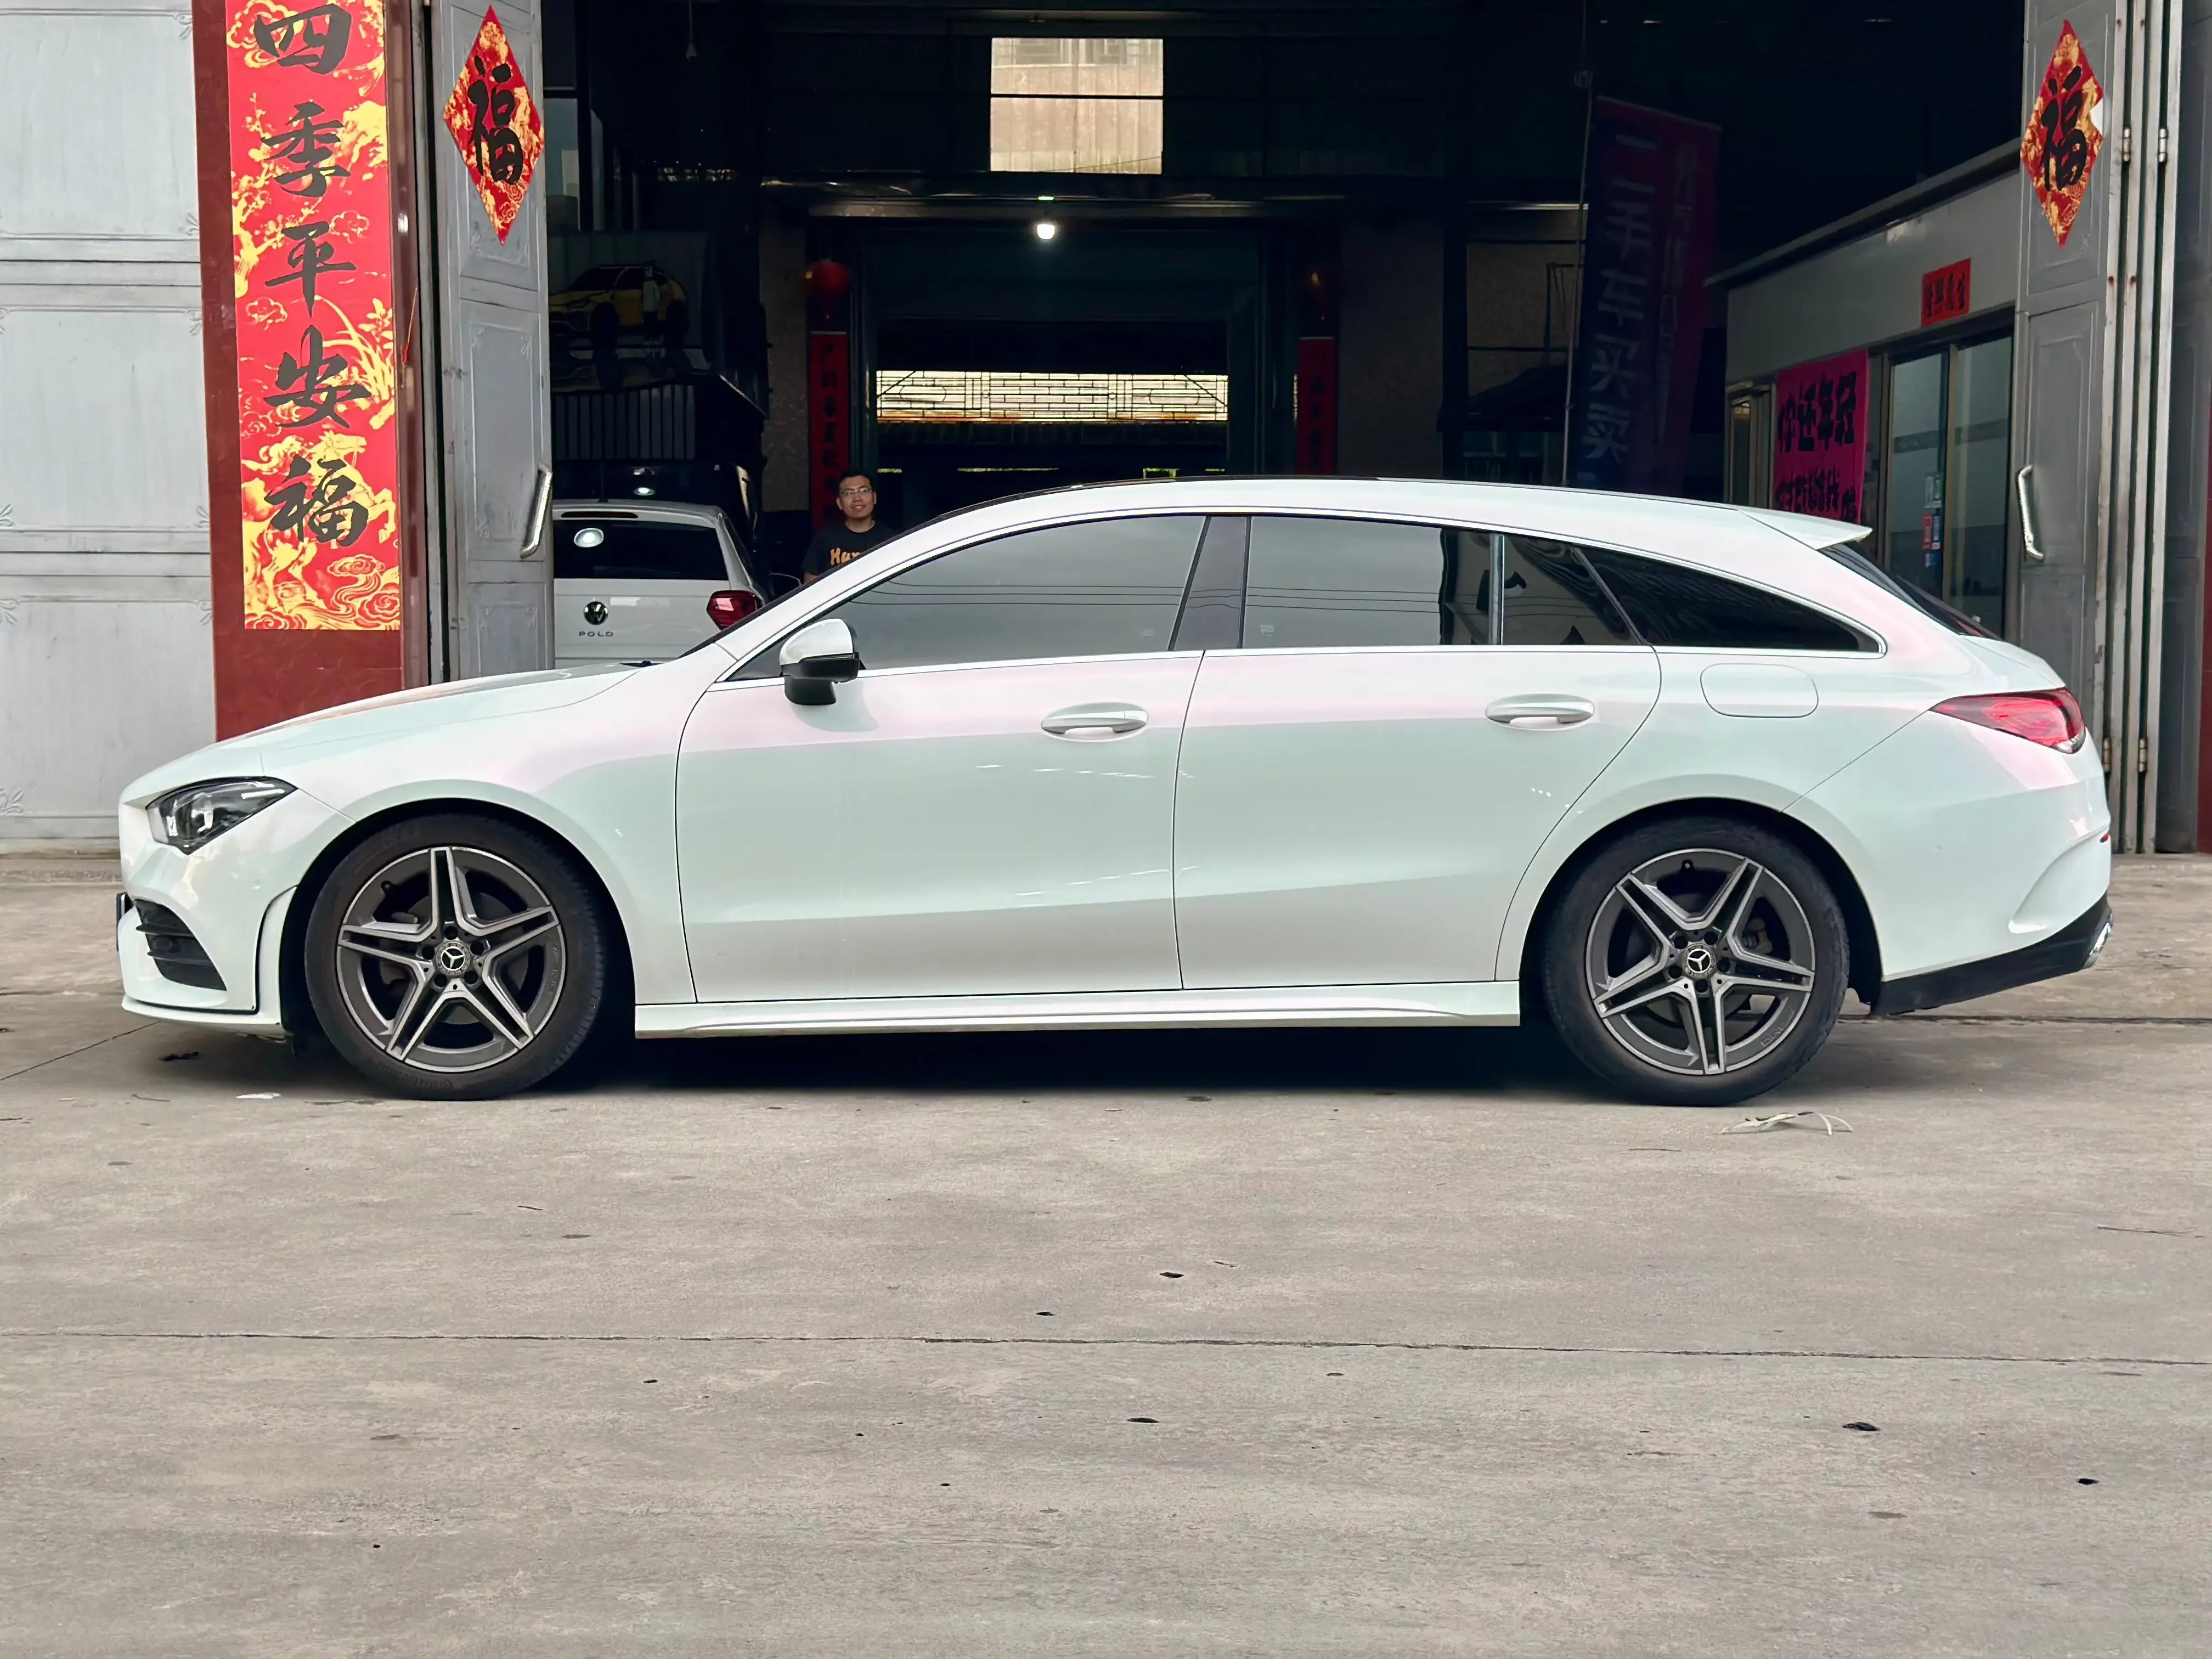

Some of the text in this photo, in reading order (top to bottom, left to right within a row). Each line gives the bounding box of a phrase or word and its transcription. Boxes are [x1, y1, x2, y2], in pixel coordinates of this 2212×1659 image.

[467, 55, 523, 186] 福
[2041, 65, 2087, 191] 福
[252, 6, 372, 548] 四季平安福
